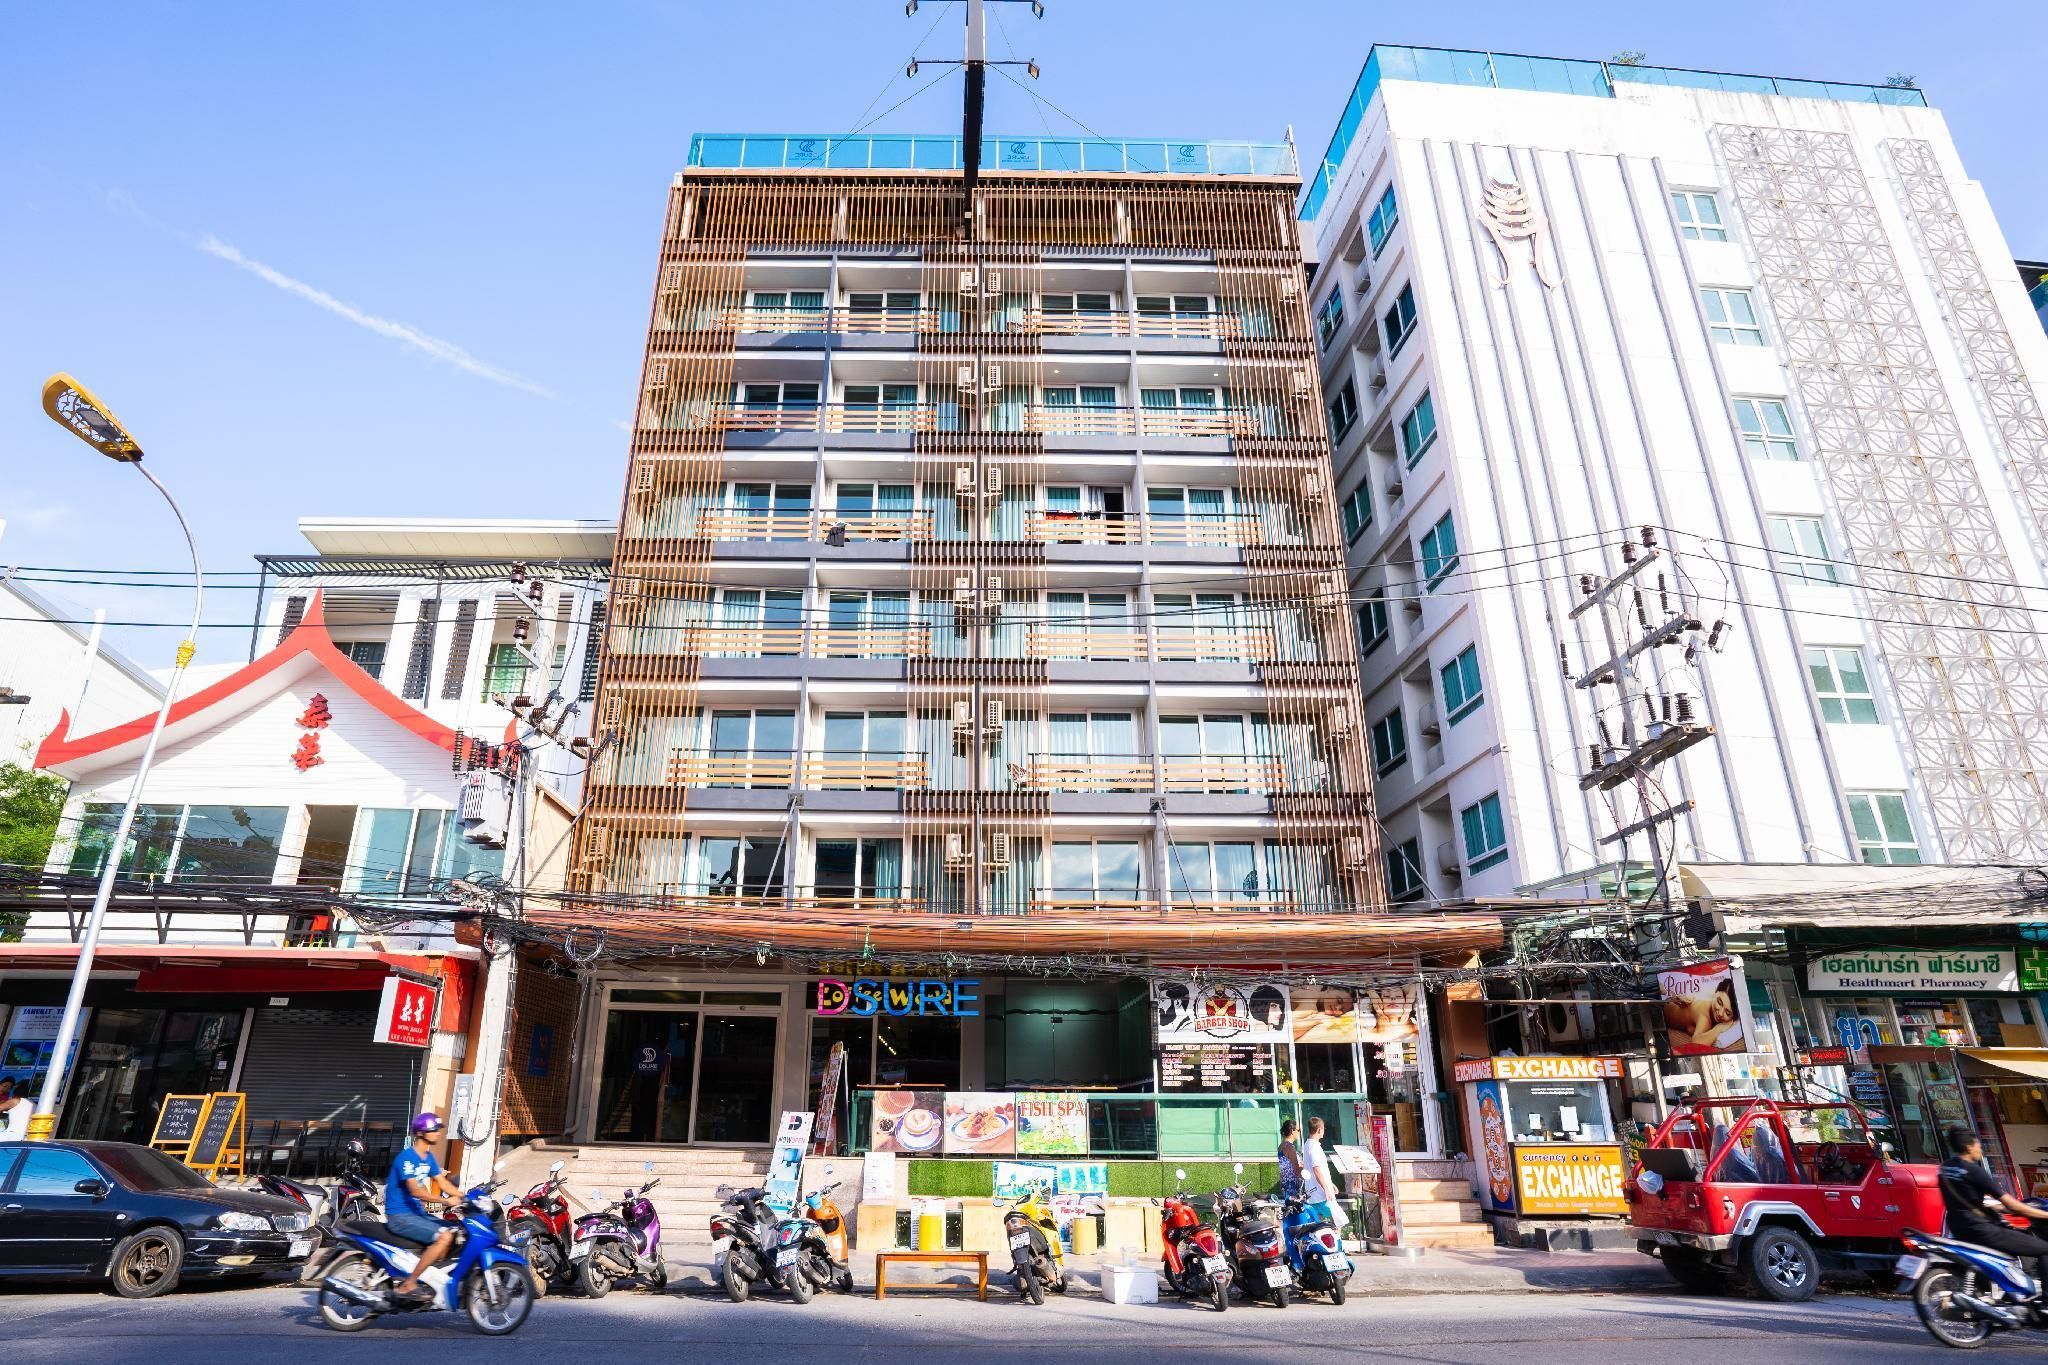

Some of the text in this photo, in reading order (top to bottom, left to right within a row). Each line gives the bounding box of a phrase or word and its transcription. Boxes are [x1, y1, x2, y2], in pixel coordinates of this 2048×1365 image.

[1664, 974, 1700, 997] Paris
[1839, 978, 1988, 989] Healthmart Pharmacy
[818, 979, 979, 1016] DSURE
[1196, 1017, 1249, 1030] BARBER SHOP
[1837, 1017, 1882, 1050] ยา
[1455, 1062, 1492, 1081] EXCHANGE
[1496, 1059, 1620, 1078] EXCHANGE
[1020, 1100, 1085, 1117] FISH SPA
[1522, 1153, 1567, 1163] currency
[1520, 1163, 1625, 1199] EXCHANGE
